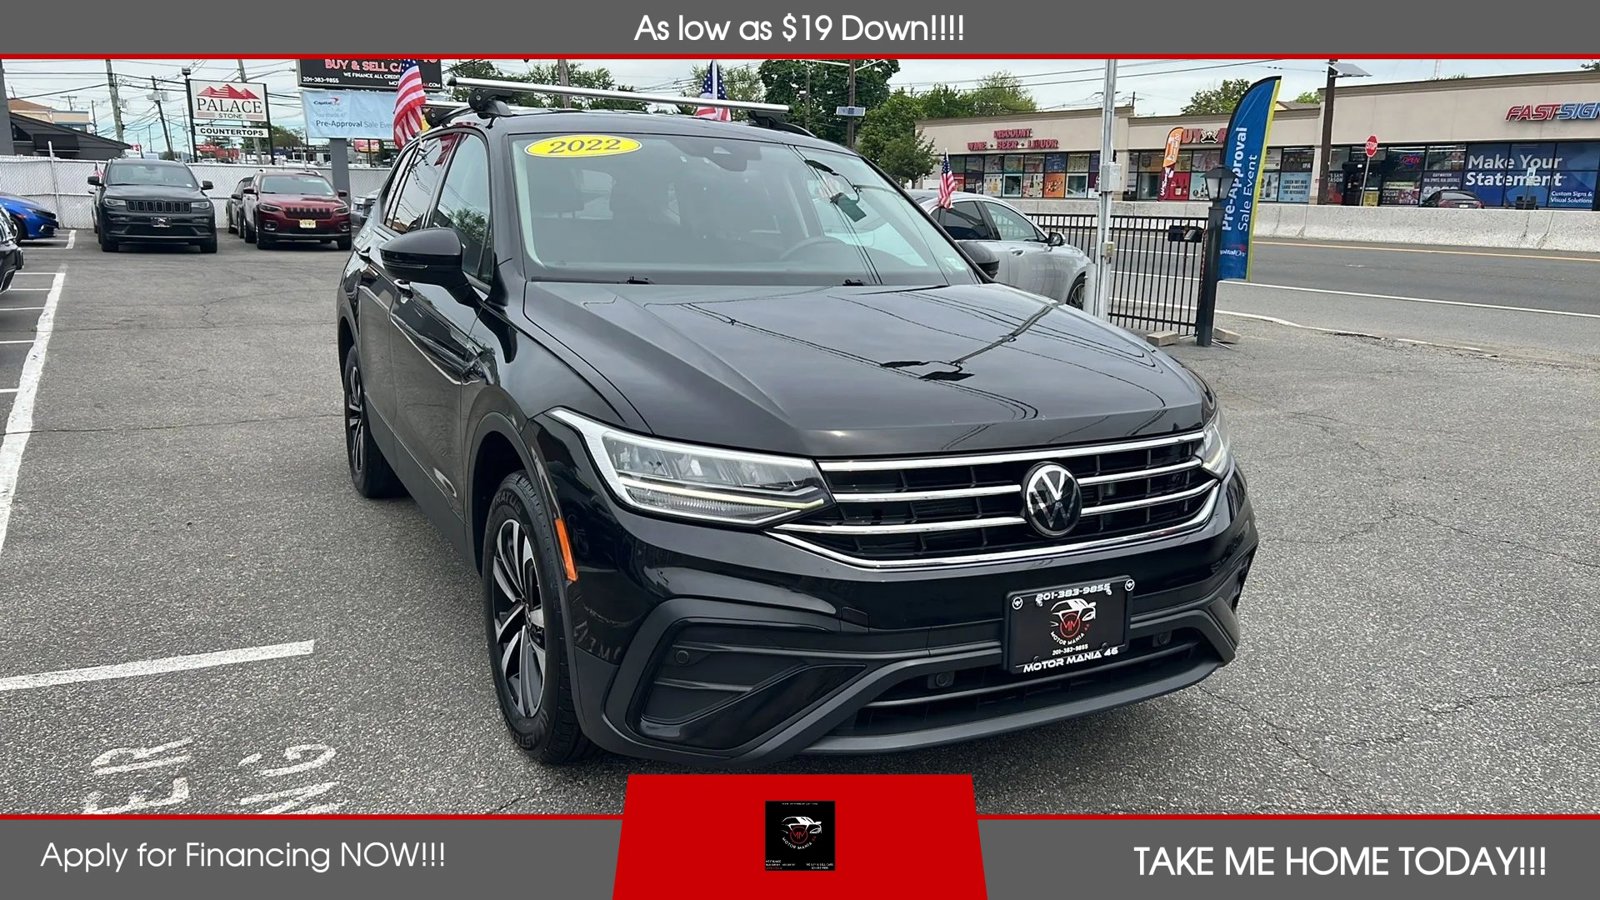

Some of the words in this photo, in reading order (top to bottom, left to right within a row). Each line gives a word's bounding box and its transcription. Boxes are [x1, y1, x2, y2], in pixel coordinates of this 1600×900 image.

[325, 59, 349, 70] BUY
[351, 61, 360, 71] &
[362, 61, 388, 72] SELL
[197, 97, 264, 115] PALACE
[200, 127, 264, 136] COUNTERTOPS
[316, 120, 363, 128] Pre-Approval
[548, 138, 621, 155] 2022
[996, 141, 1020, 151] BEER
[1468, 154, 1515, 169] Make
[1520, 154, 1562, 169] Your
[1222, 127, 1248, 231] Pre-Approval
[1243, 154, 1258, 197] Event
[1465, 172, 1562, 186] Statement
[1572, 190, 1586, 198] Signs
[1238, 202, 1253, 232] Sale
[1036, 583, 1111, 601] 201-383-9855
[1023, 658, 1064, 673] MOTOR
[1066, 651, 1102, 665] MANIA
[1104, 647, 1119, 657] 46
